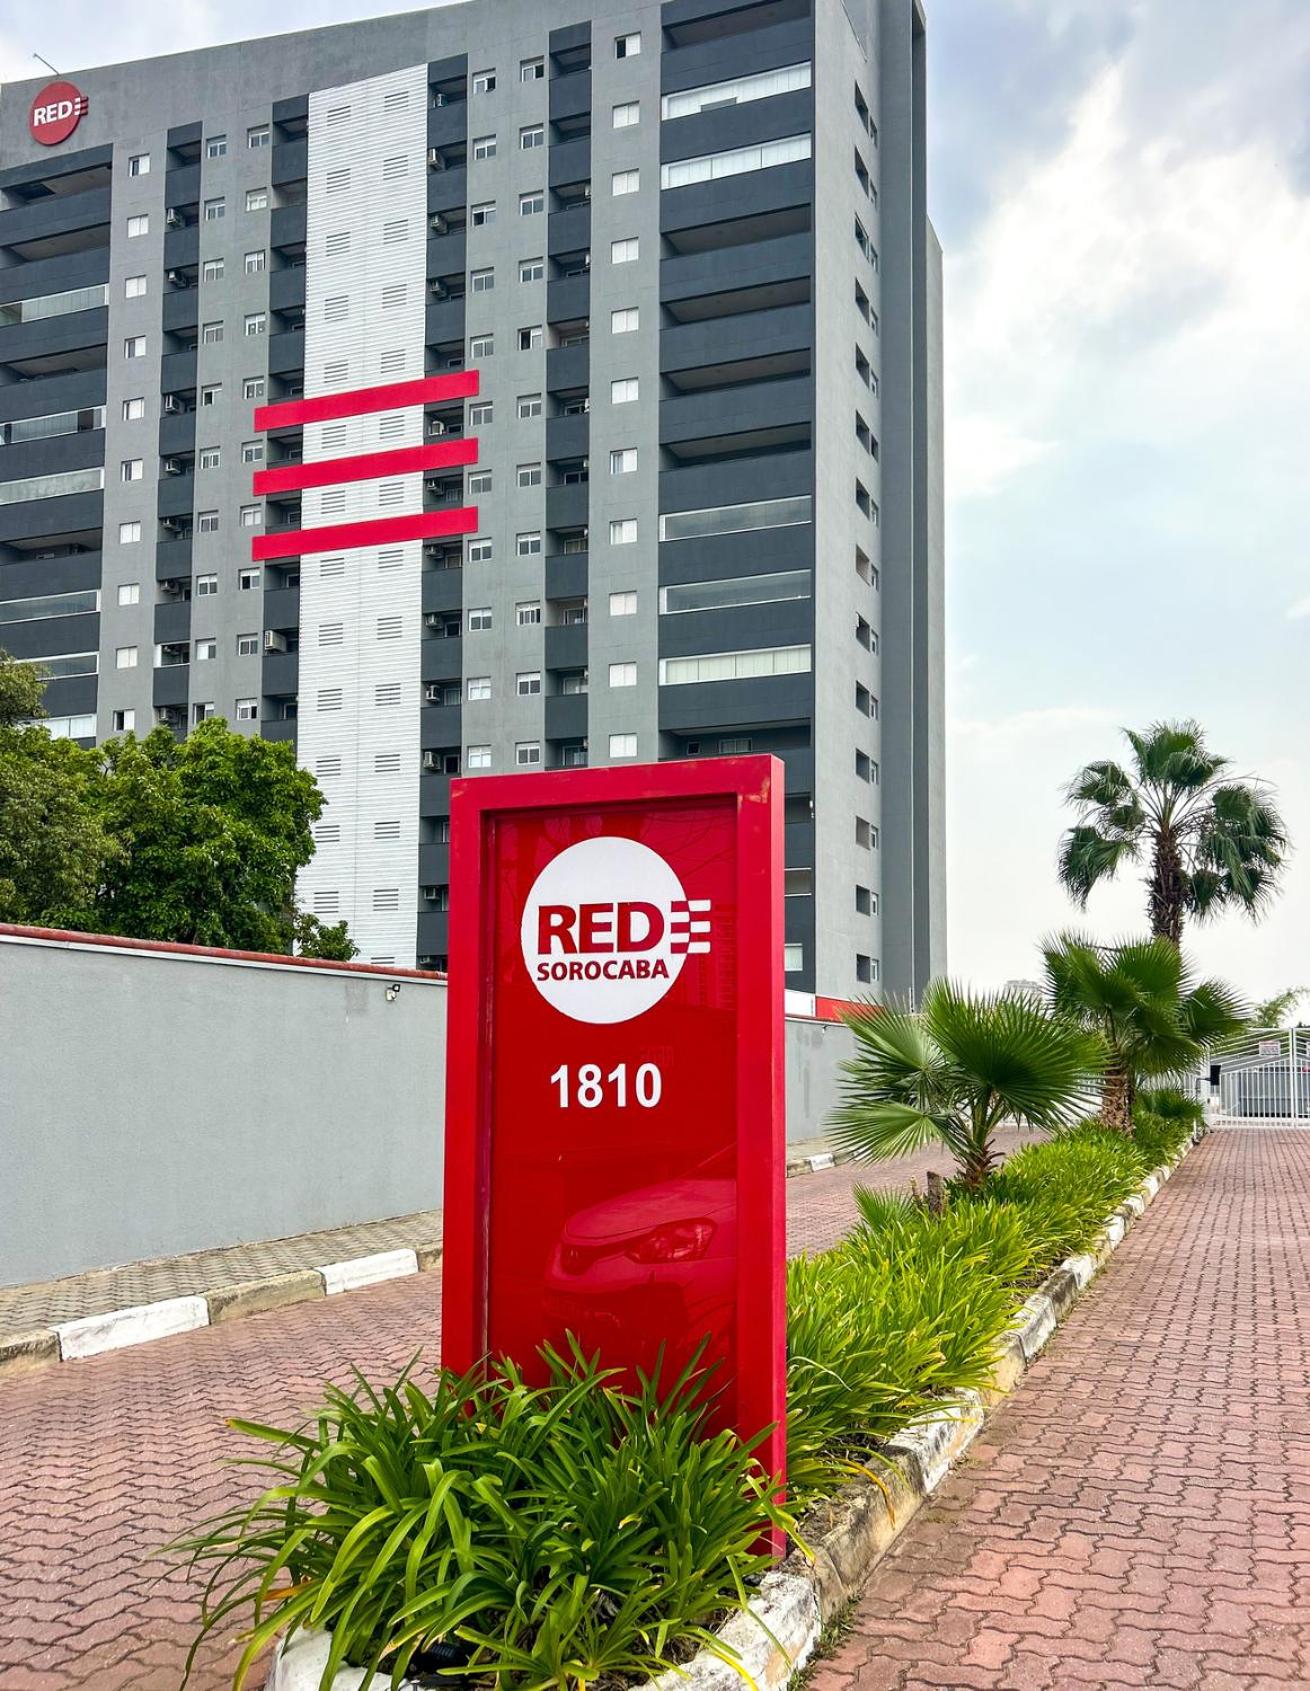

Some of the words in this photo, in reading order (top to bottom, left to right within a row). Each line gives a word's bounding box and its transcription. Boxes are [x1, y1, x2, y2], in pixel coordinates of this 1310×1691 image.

[34, 101, 73, 126] RED
[538, 902, 664, 954] RED
[537, 960, 669, 981] SOROCABA
[550, 1063, 662, 1108] 1810
